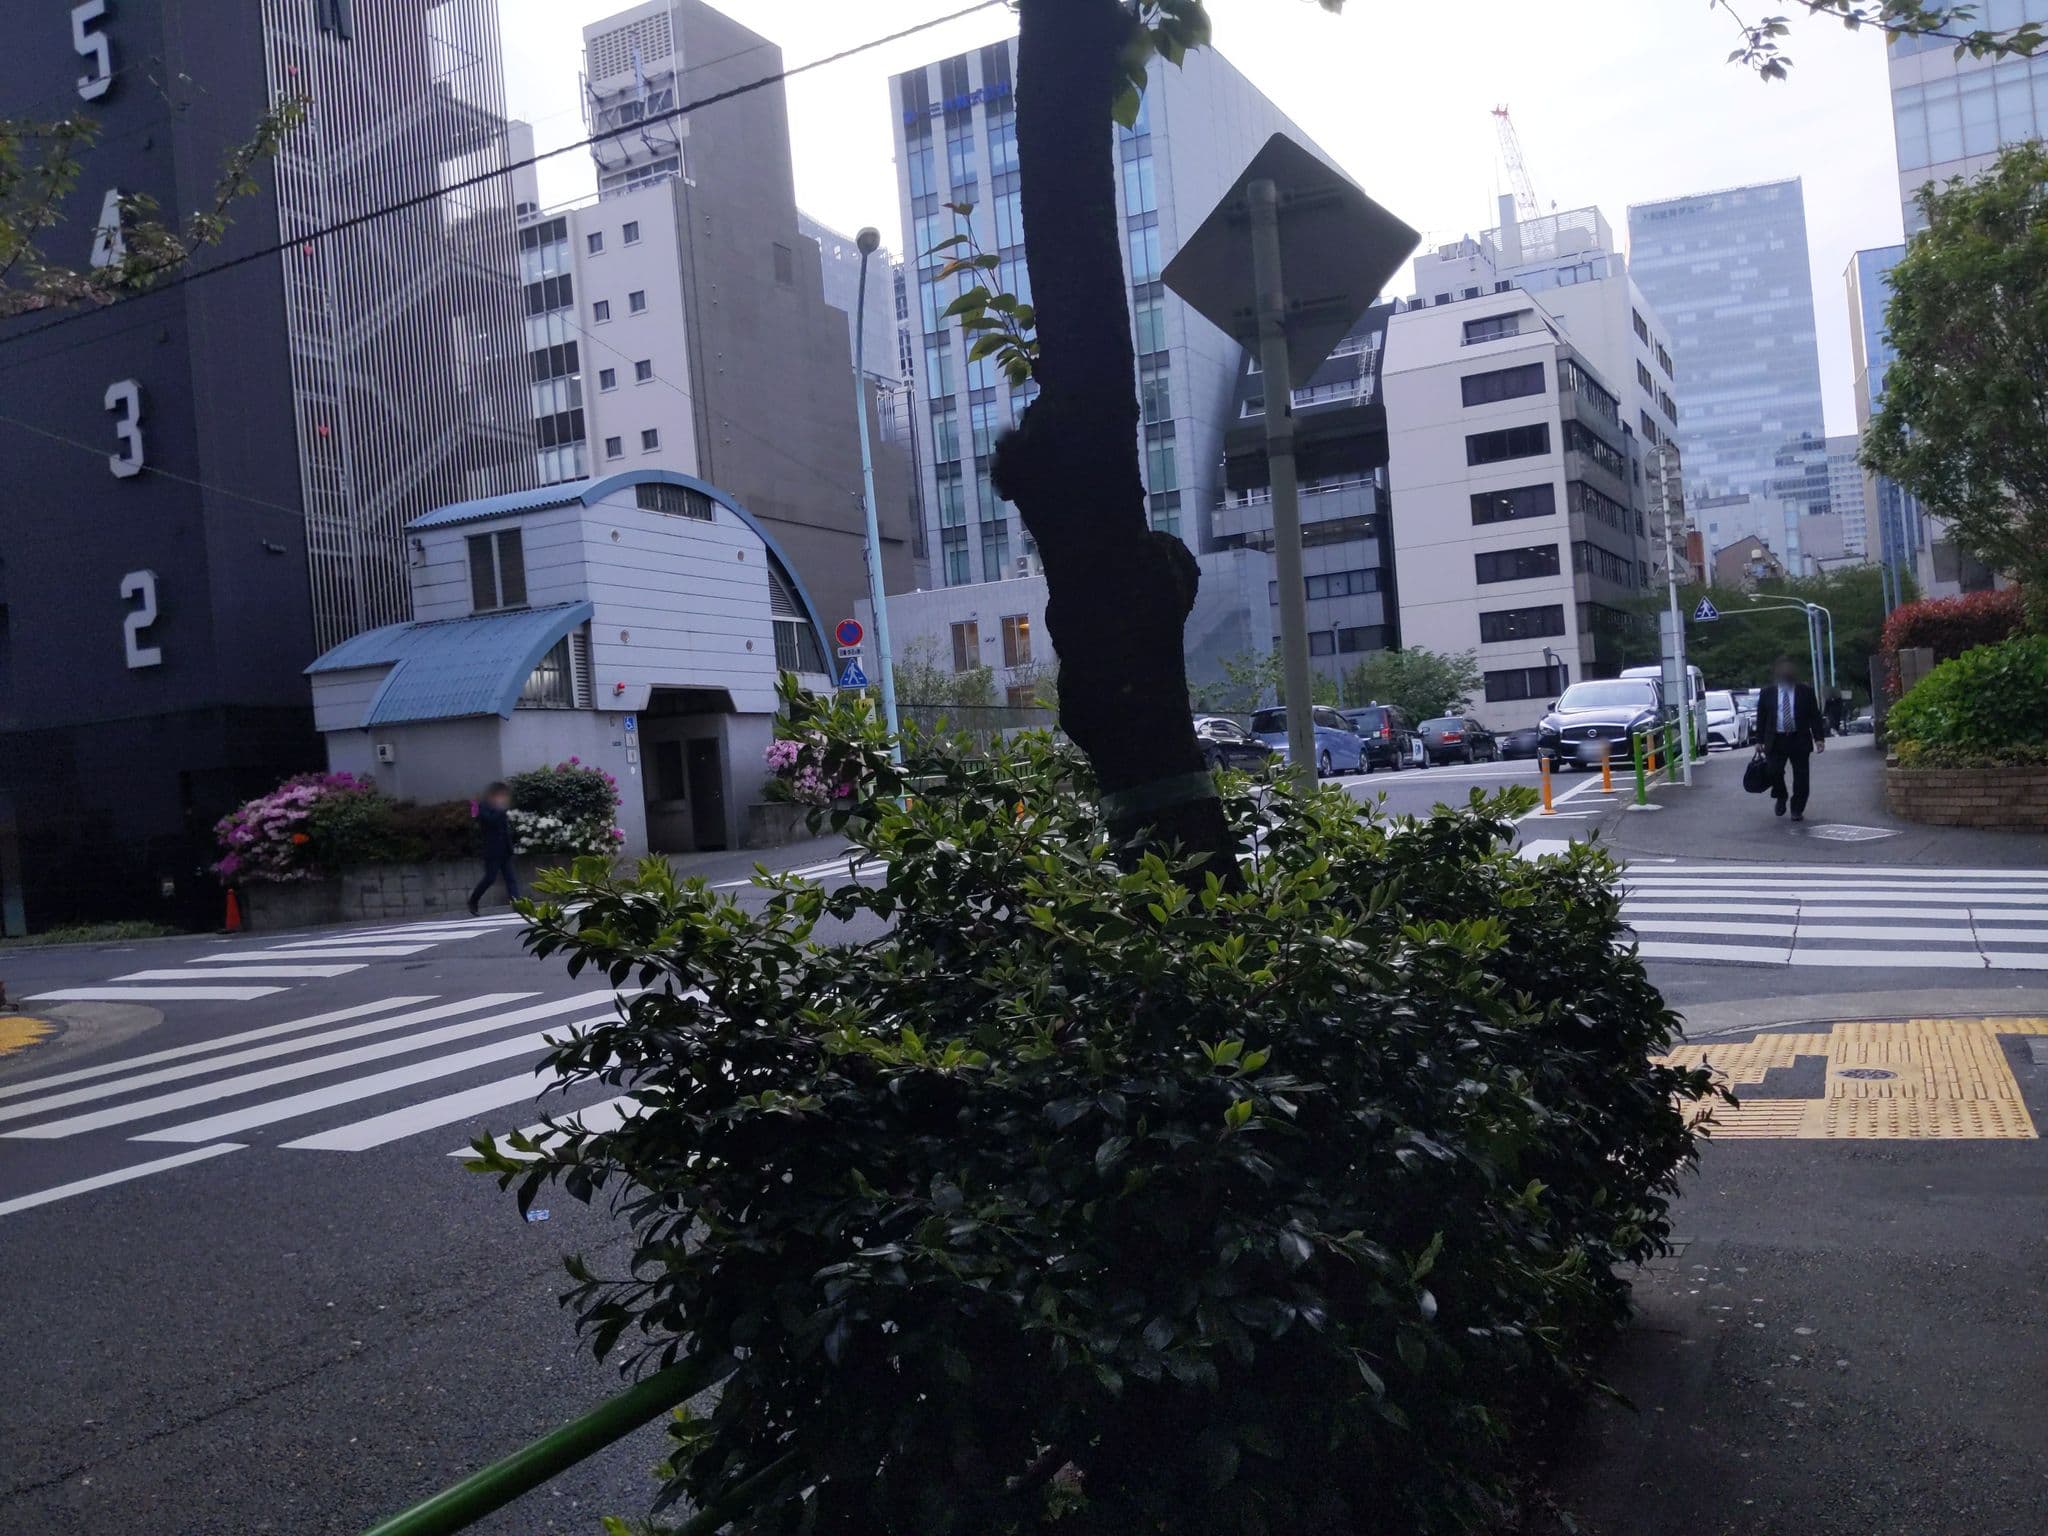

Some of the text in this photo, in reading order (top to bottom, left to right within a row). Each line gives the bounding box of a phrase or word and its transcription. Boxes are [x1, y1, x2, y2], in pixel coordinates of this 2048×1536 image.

[71, 0, 112, 101] 5
[104, 379, 144, 478] 3
[121, 569, 162, 669] 2
